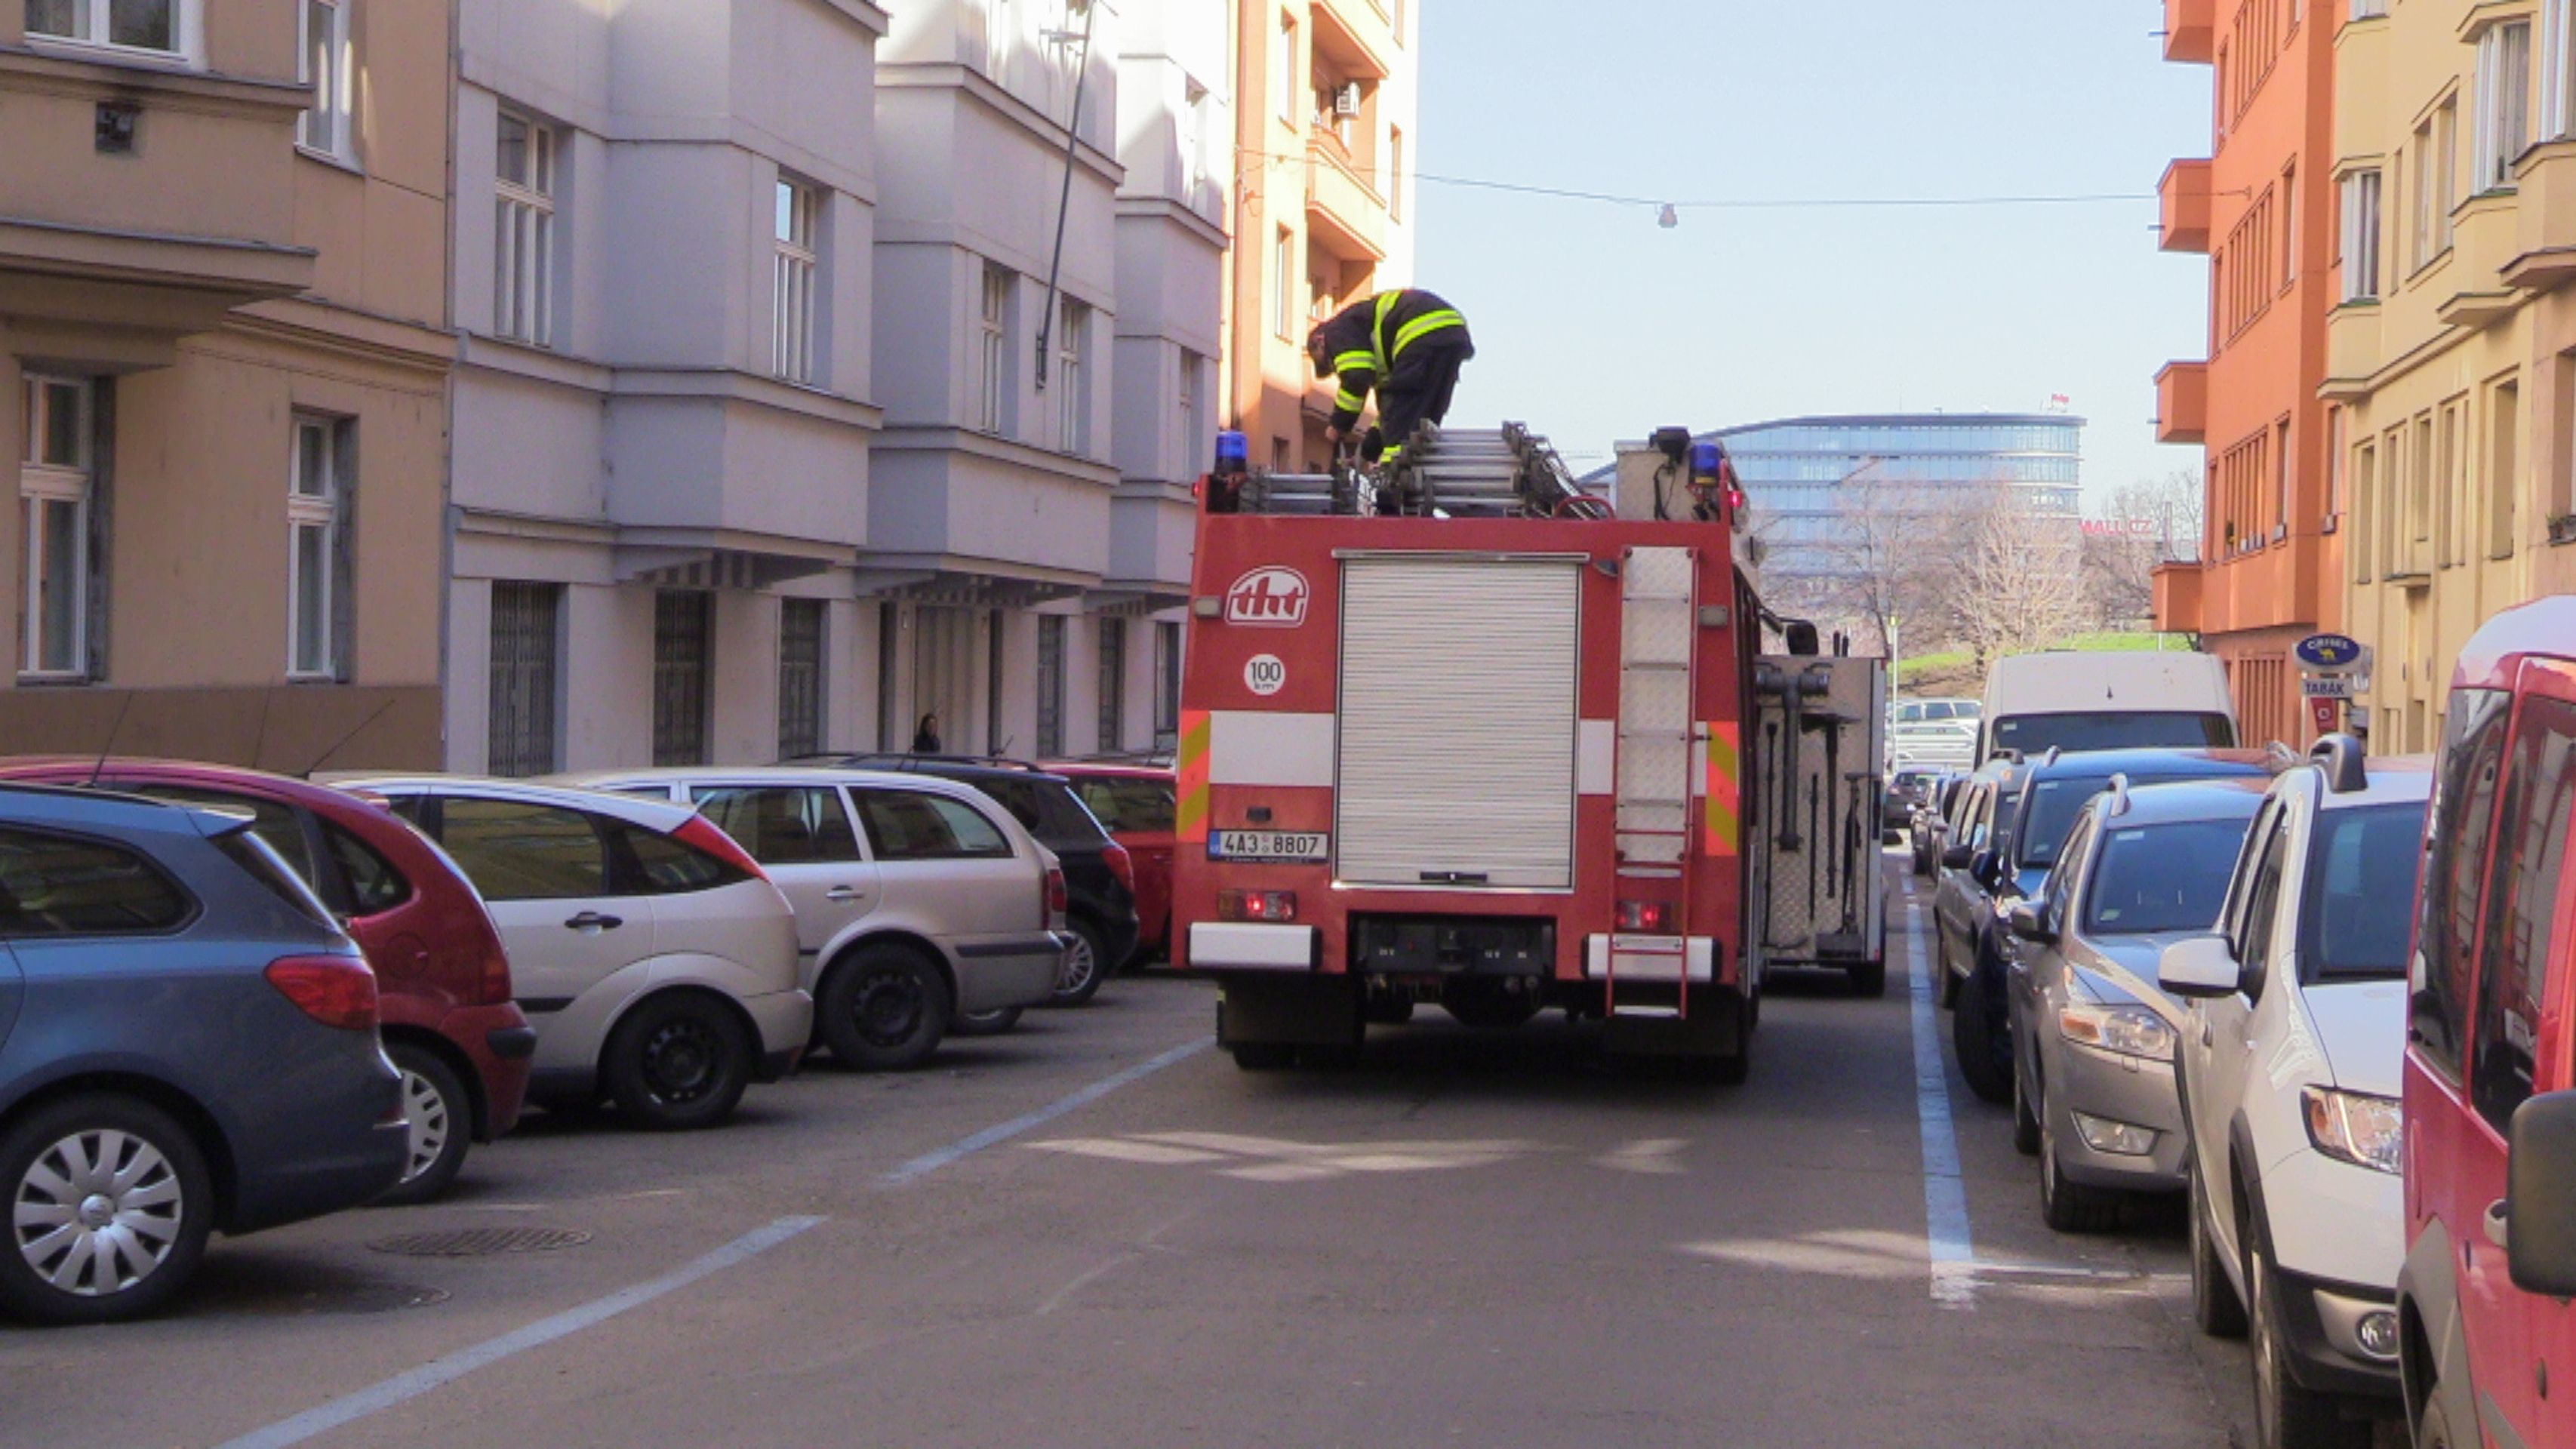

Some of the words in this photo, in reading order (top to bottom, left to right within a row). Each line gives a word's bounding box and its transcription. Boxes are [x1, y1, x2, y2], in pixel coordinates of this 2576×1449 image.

[1250, 662, 1282, 681] 100
[1224, 833, 1258, 853] 4A3
[1273, 835, 1319, 854] 8807
